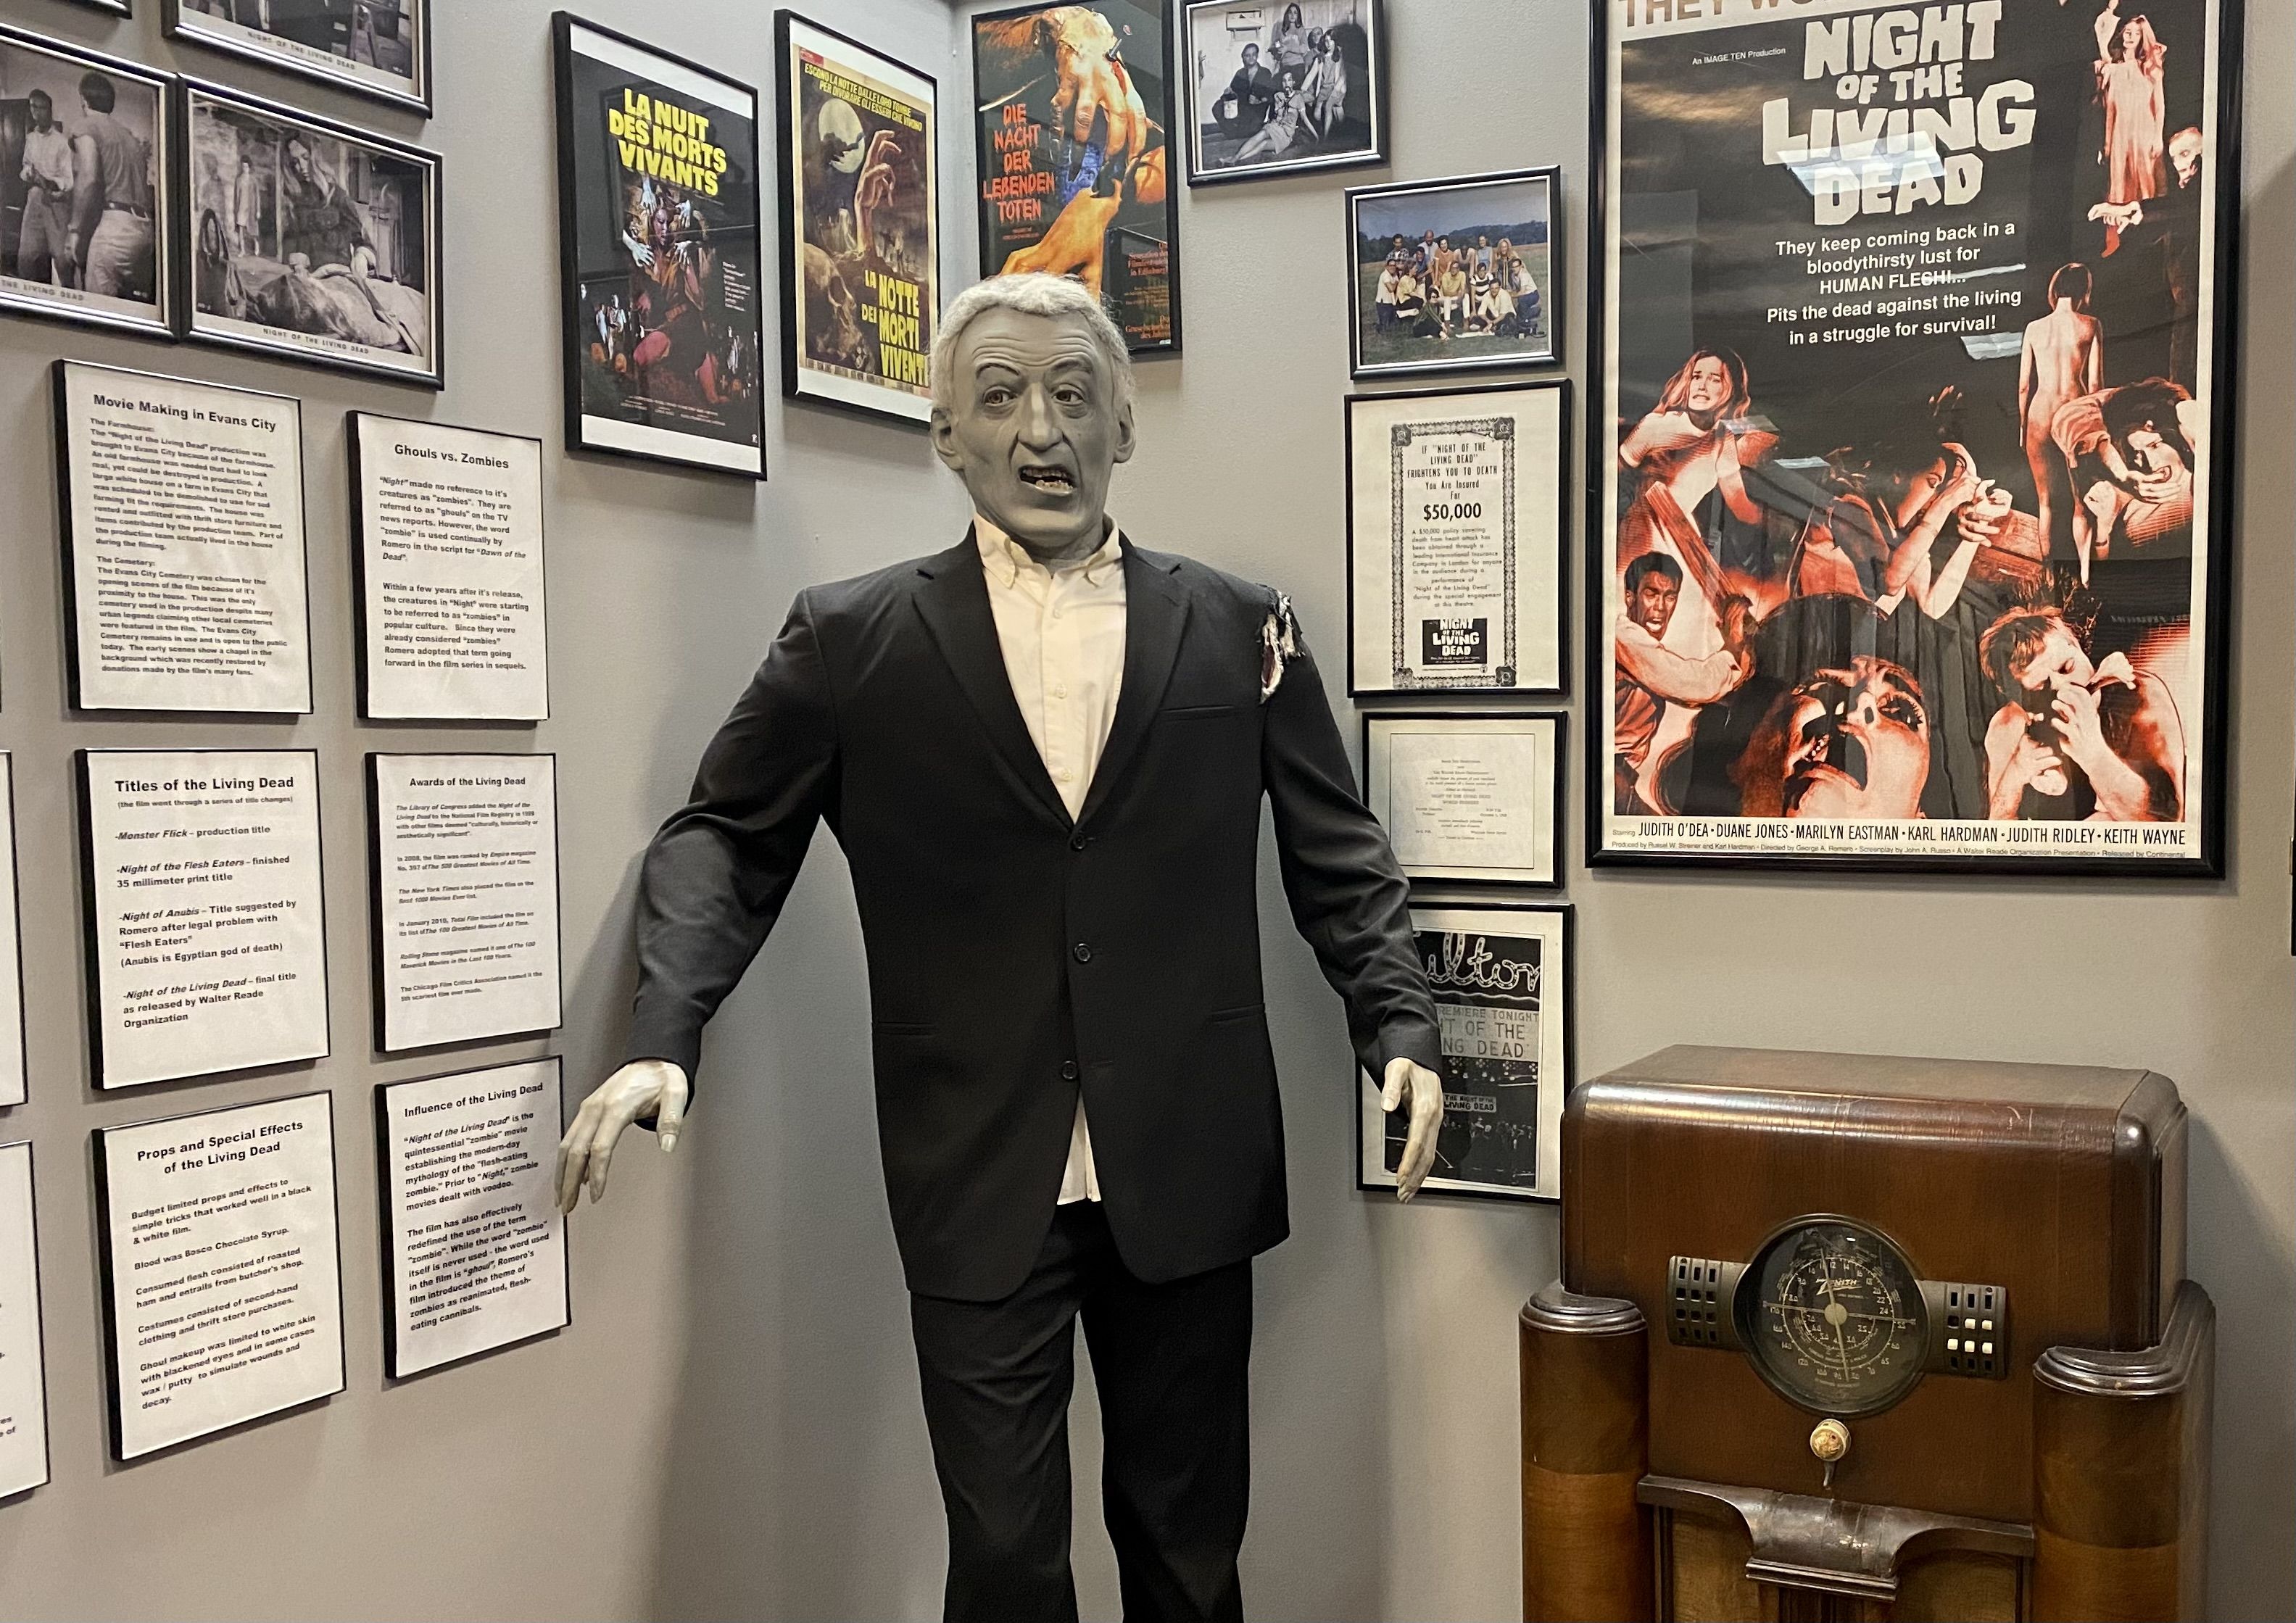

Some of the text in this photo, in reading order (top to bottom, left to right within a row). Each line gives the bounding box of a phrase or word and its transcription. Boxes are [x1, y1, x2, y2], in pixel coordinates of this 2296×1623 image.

[1804, 0, 2002, 80] NIGHT
[1703, 53, 1729, 63] IMAGE
[1730, 51, 1746, 60] TEN
[1747, 47, 1786, 58] Production
[1836, 62, 1963, 104] OF THE
[624, 88, 709, 144] LA NUIT
[1003, 104, 1027, 126] DIE
[1762, 78, 2037, 165] LIVING
[609, 108, 727, 173] DES MORTS
[995, 124, 1042, 149] NACHT
[618, 138, 719, 197] VIVANTS
[1003, 150, 1032, 174] DER
[983, 171, 1056, 201] LEBENDEN
[1813, 153, 1984, 225] DEAD
[997, 199, 1042, 222] TOTEN
[1775, 222, 2015, 257] They keep coming back in a
[1807, 246, 1981, 275] bloodythirsty lust for
[865, 270, 919, 317] LA NOTTE
[1820, 275, 1884, 294] HUMAN
[1767, 289, 2021, 323] Pits the dead against the living
[861, 304, 919, 352] DEI MORTI
[1789, 314, 1996, 345] in a struggle for survival!
[880, 343, 929, 386] VIVENTI
[94, 394, 275, 433] Movie Making in Evans City
[394, 444, 509, 468] Ghouls vs. Zombies
[1430, 454, 1451, 465] LIVING
[1406, 465, 1497, 478] FRIGHTENS YOU TO DEATH
[1425, 479, 1479, 490] You Are Insured
[1450, 490, 1460, 500] For
[1423, 502, 1481, 522] $50,000
[382, 581, 407, 591] Within
[416, 584, 432, 592] few
[492, 590, 523, 599] release,
[1440, 618, 1473, 630] NIGHT
[1433, 631, 1479, 645] LIVING
[1442, 645, 1471, 656] DEAD
[114, 776, 294, 792] Titles of the Living Dead
[446, 777, 455, 786] of
[475, 777, 502, 787] Living
[504, 776, 526, 785] Dead
[1638, 822, 1673, 837] JUDITH
[1678, 823, 1709, 837] O'DEA
[1717, 823, 1752, 838] DUANE
[1754, 824, 1788, 839] JONES
[1796, 824, 1844, 839] MARILYN
[1849, 826, 1899, 840] EASTMAN
[1908, 826, 1936, 841] KARL
[1941, 826, 1997, 842] HARDMAN
[2007, 827, 2047, 842] JUDITH
[2054, 829, 2095, 843] RIDLEY
[2105, 829, 2137, 844] KEITH
[2143, 829, 2186, 844] WAYNE
[174, 950, 217, 962] Egyptian
[220, 946, 238, 958] god
[240, 945, 249, 954] of
[1438, 1006, 1539, 1023] REMIERE TONIGHT
[1466, 1021, 1485, 1036] OF
[1494, 1022, 1525, 1039] THE
[1478, 1040, 1523, 1058] DEAD
[404, 1082, 543, 1117] Influence of the Living Dead
[137, 1121, 303, 1161] Props and Special Effects
[164, 1141, 280, 1174] of the Living Dead
[130, 1206, 165, 1219] Budget
[167, 1197, 198, 1211] limited
[201, 1193, 226, 1205] props
[228, 1187, 244, 1197] and
[246, 1182, 278, 1193] effects
[406, 1203, 523, 1237] The film has also effectively
[410, 1304, 481, 1331] eating cannibals.
